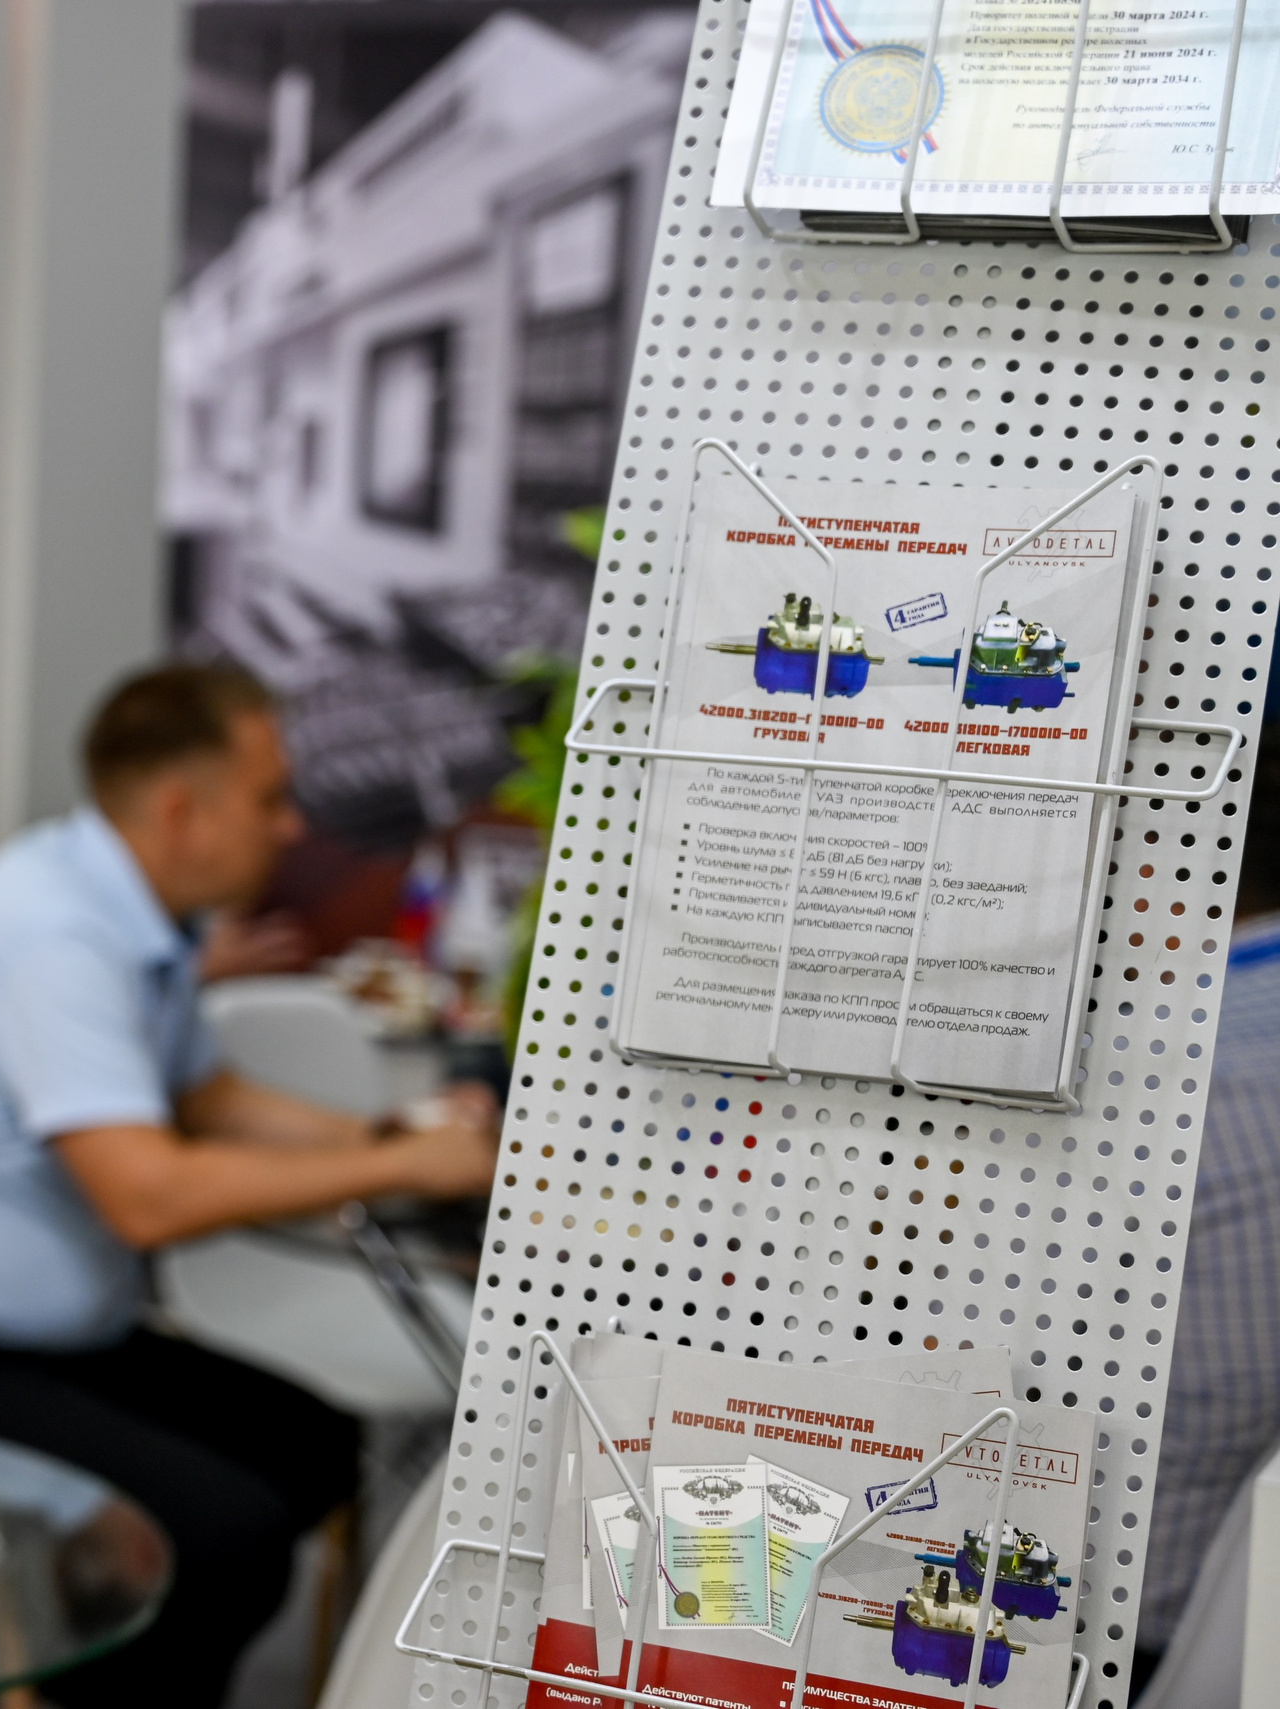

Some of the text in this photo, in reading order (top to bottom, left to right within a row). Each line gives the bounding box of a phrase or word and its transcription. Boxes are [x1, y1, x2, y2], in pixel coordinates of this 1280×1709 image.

[1111, 10, 1126, 20] 30
[1128, 11, 1166, 22] марта
[1169, 10, 1196, 20] 2024
[1199, 11, 1210, 19] г.
[1123, 49, 1136, 59] 21
[1139, 50, 1173, 59] июня
[1177, 48, 1204, 58] 2024
[1207, 49, 1218, 57] г.
[1103, 76, 1119, 86] 30
[1122, 77, 1159, 87] марта
[1162, 74, 1189, 85] 2034
[778, 515, 921, 535] ПТИСТУПЕНЧАТАЯ
[726, 530, 796, 547] КОРОБКА
[897, 540, 968, 556] ПЕРЕДАЧ
[993, 536, 1107, 551] AVODETAL
[753, 726, 826, 744] ГРУЗОВЯ
[956, 741, 1031, 756] ЛЕГКОВАЯ
[708, 767, 725, 780] По
[727, 769, 774, 784] каждой
[884, 784, 935, 797] коробке
[1027, 792, 1080, 804] передач
[686, 796, 761, 812] соблюдение
[687, 781, 714, 792] Для
[720, 784, 801, 801] автомобиле
[816, 791, 844, 804] УАЗ
[951, 802, 983, 815] АДС
[989, 806, 1077, 819] выполняется
[699, 823, 757, 840] Проверка
[827, 836, 890, 850] скоростей
[743, 845, 776, 858] шума
[806, 850, 825, 862] дБ
[828, 850, 845, 864] (81
[845, 854, 865, 866] дБ
[867, 855, 889, 867] без
[890, 859, 953, 873] нагруки);
[694, 855, 752, 871] Усиление
[754, 864, 768, 873] на
[819, 867, 835, 880] 59
[849, 870, 862, 884] (6
[942, 877, 964, 889] без
[966, 881, 1028, 895] заеданий;
[688, 887, 780, 908] Присваивается
[691, 871, 783, 891] Герметичность
[810, 886, 878, 899] давлением
[880, 889, 903, 902] 19,6
[930, 893, 956, 906] (0,2
[686, 904, 703, 915] На
[705, 907, 754, 922] каждую
[756, 912, 785, 924] КПП
[681, 931, 777, 953] Производитель
[817, 949, 880, 965] отгрузкой
[959, 959, 989, 972] 100%
[990, 962, 1046, 976] качество
[1047, 967, 1056, 976] и
[838, 965, 892, 979] агрегата
[673, 976, 700, 989] Для
[823, 995, 839, 1005] по
[841, 994, 869, 1007] КПП
[919, 1002, 994, 1018] обращаться
[995, 1010, 1002, 1019] к
[1004, 1010, 1050, 1023] своему
[655, 990, 751, 1012] региональному
[823, 1011, 846, 1020] или
[937, 1020, 980, 1032] отдела
[981, 1024, 1031, 1037] продаж.
[726, 1397, 875, 1434] ПЯТИСТУПЕНЧАТАЯ
[671, 1410, 746, 1435] КОРОБКА
[753, 1423, 843, 1450] ПЕРЕМЕНЫ
[850, 1438, 925, 1463] ПЕРЕДАЧ
[956, 1446, 1068, 1474] VTOETAL
[966, 1472, 1048, 1490] ULYAOVSK
[926, 1546, 955, 1556] ЛЕГКОВАЯ
[862, 1607, 894, 1618] ГРУЗОВАЯ
[546, 1686, 591, 1705] (выдано
[641, 1683, 704, 1704] Действуют
